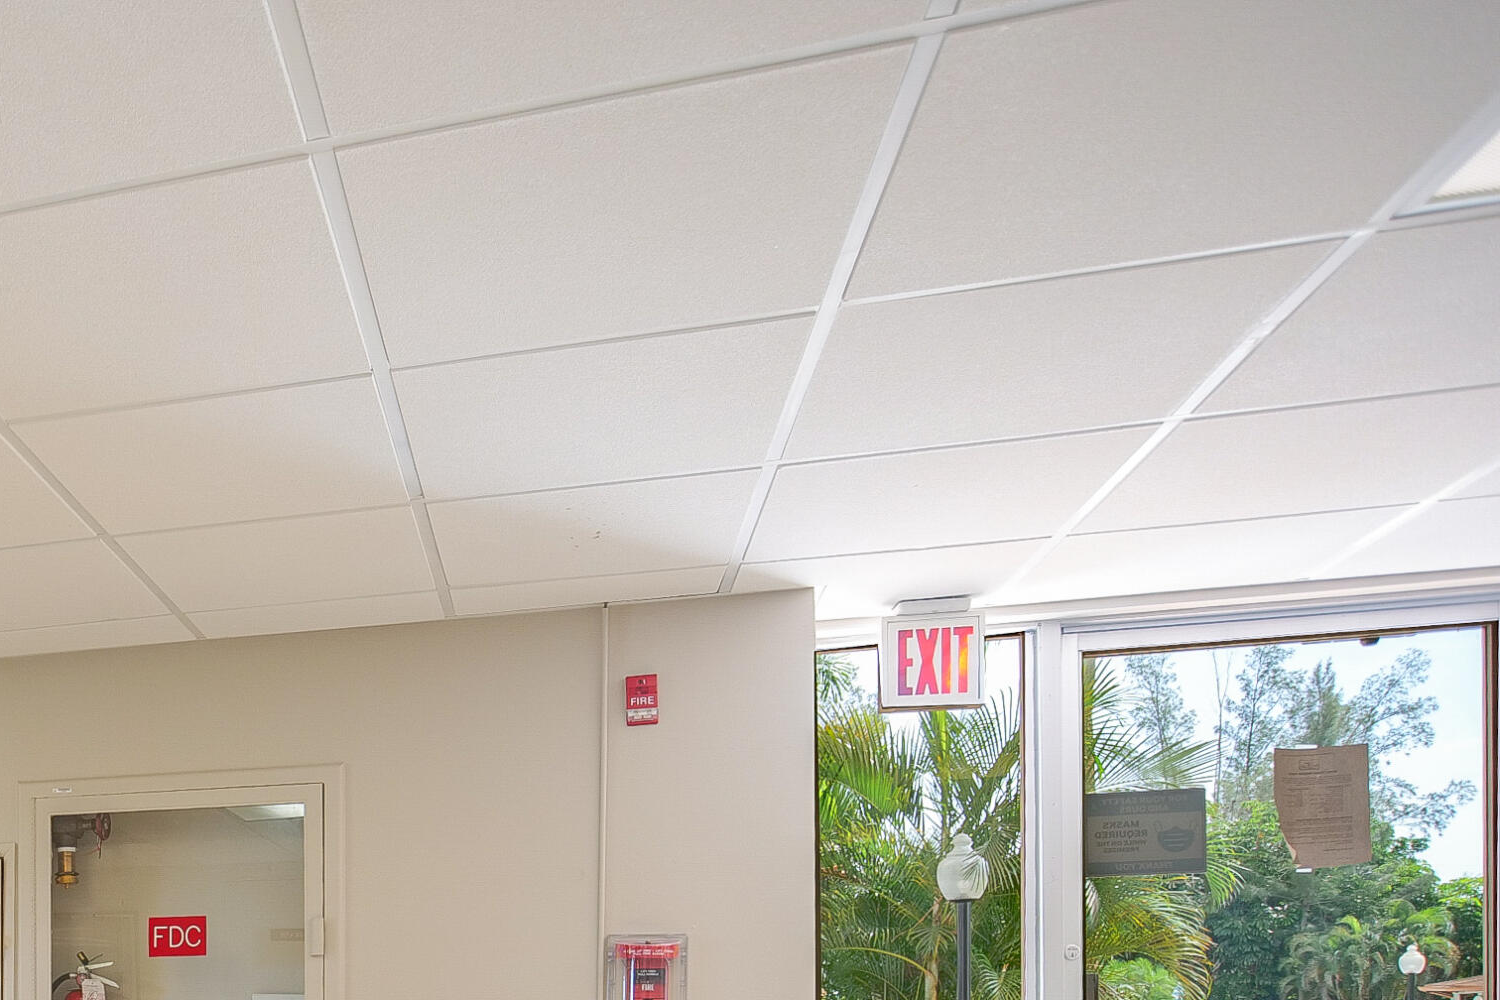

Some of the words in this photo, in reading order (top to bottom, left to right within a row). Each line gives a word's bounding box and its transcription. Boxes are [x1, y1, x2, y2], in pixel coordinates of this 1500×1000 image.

[898, 626, 974, 696] EXIT
[630, 696, 655, 706] FIRE
[153, 925, 202, 949] FDC
